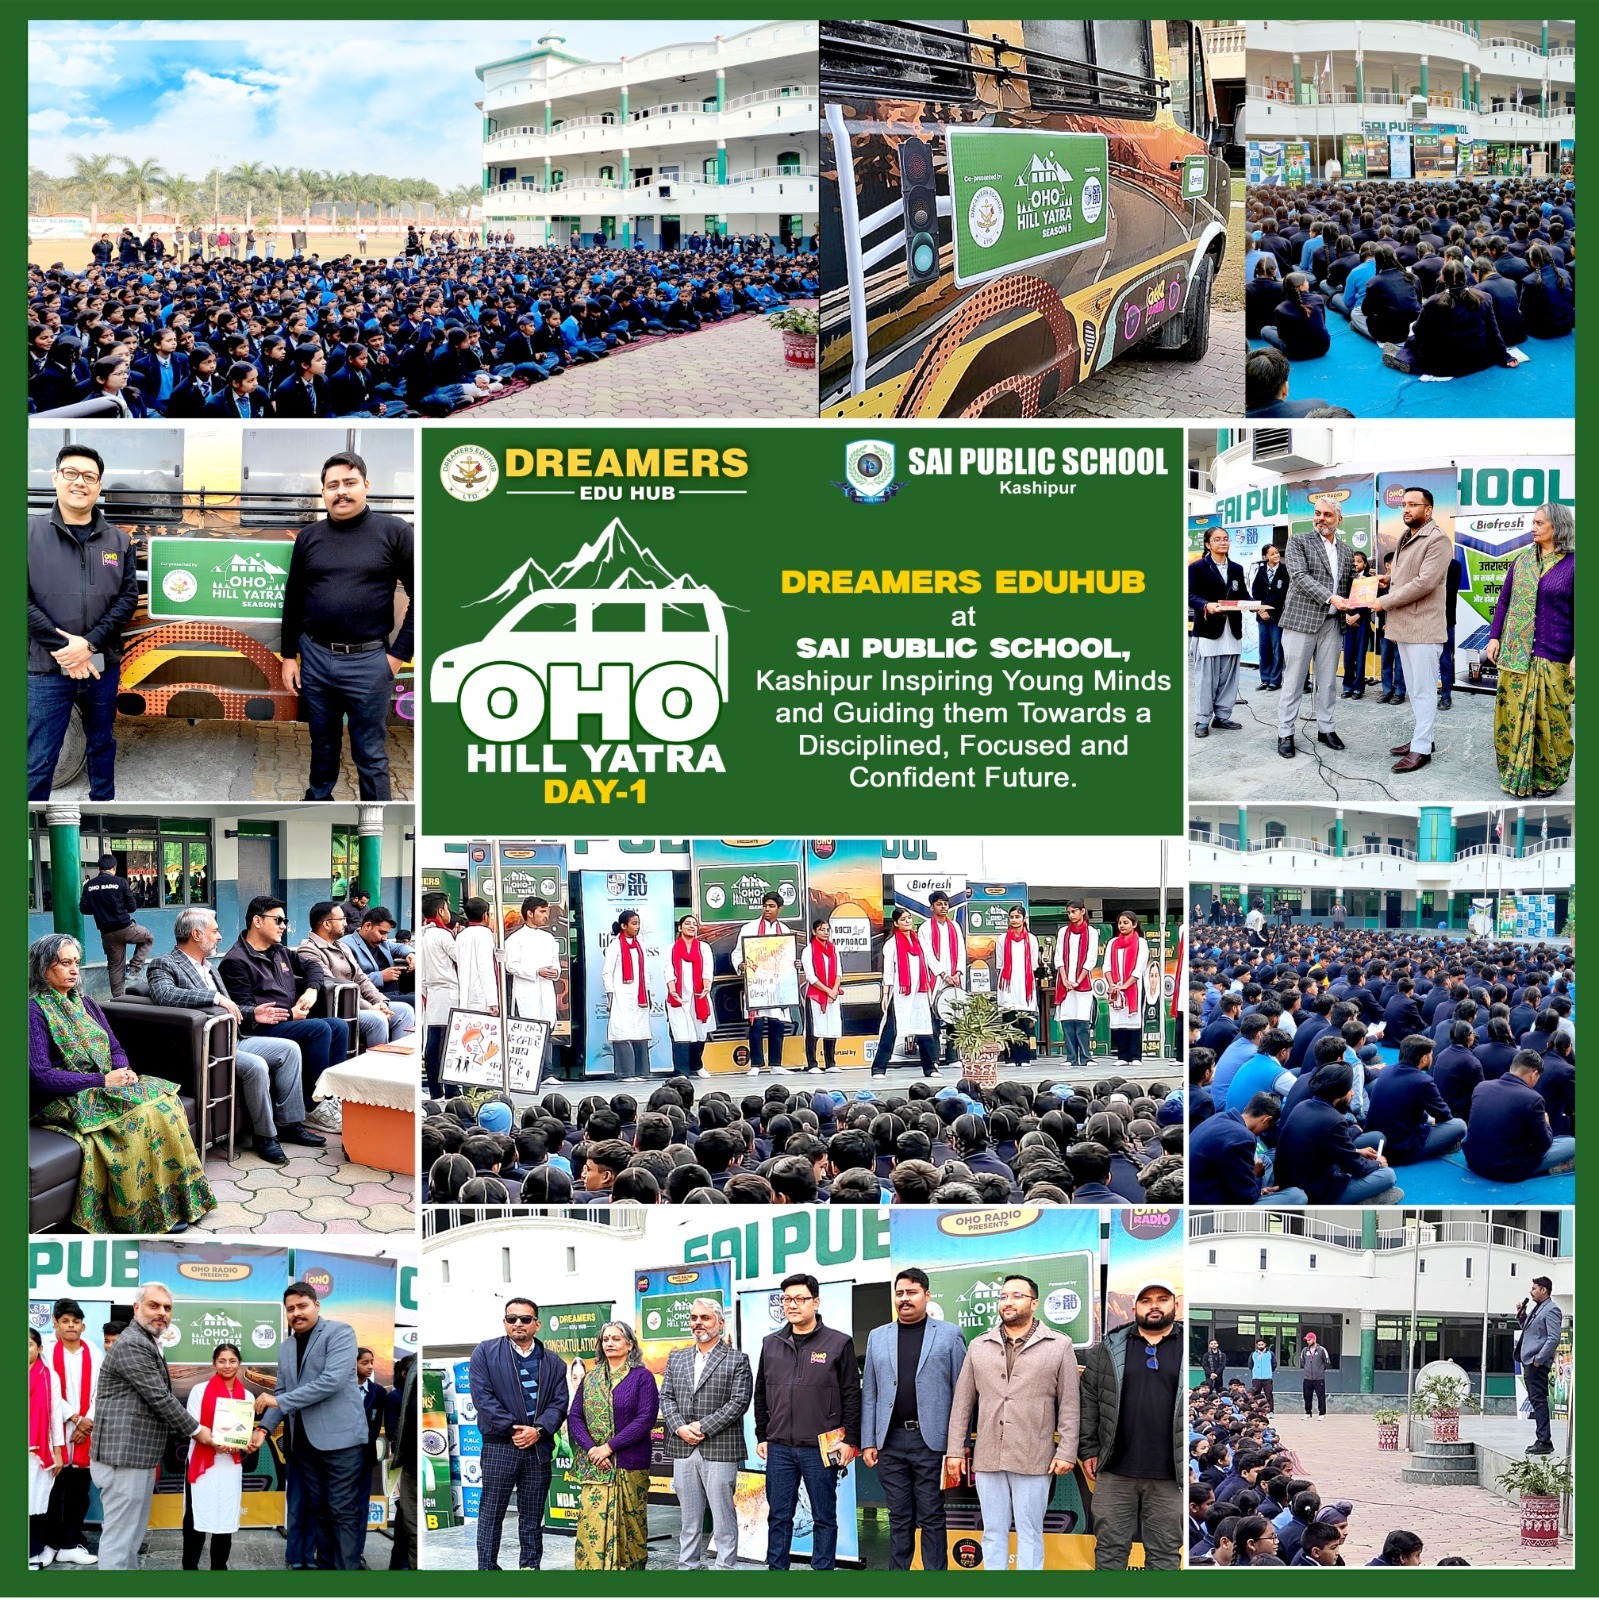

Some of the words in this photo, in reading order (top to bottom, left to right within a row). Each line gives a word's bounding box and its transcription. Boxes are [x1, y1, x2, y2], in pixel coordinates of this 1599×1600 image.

[1031, 188, 1060, 208] OHO
[1017, 213, 1040, 231] HILL
[1042, 206, 1072, 225] YATRA
[1042, 224, 1067, 238] SEASON
[1388, 489, 1404, 498] OHO
[1476, 516, 1525, 530] Biofresh
[1246, 528, 1258, 536] SR
[1246, 536, 1258, 544] HU
[229, 576, 267, 588] OHO
[212, 589, 239, 599] HILL
[243, 590, 285, 601] YATRA
[627, 872, 648, 885] SR
[912, 877, 952, 890] Biofresh
[627, 884, 648, 897] HU
[741, 889, 761, 897] OHO
[955, 1215, 981, 1226] OHO
[984, 1210, 1022, 1223] RADIO
[1133, 1213, 1171, 1226] RADIO
[968, 1220, 1009, 1231] PRESENTS
[684, 1221, 759, 1280] SAI
[211, 1266, 238, 1274] RADIO
[308, 1274, 330, 1284] OHO
[1062, 1294, 1078, 1302] SR
[974, 1302, 1001, 1315] OH
[1062, 1301, 1078, 1310] HU
[559, 1312, 596, 1324] DREAMERS
[673, 1312, 690, 1320] OHO
[958, 1317, 984, 1327] HILL
[203, 1328, 230, 1337] OHO
[192, 1337, 210, 1345] HILL
[212, 1338, 242, 1346] YATRA
